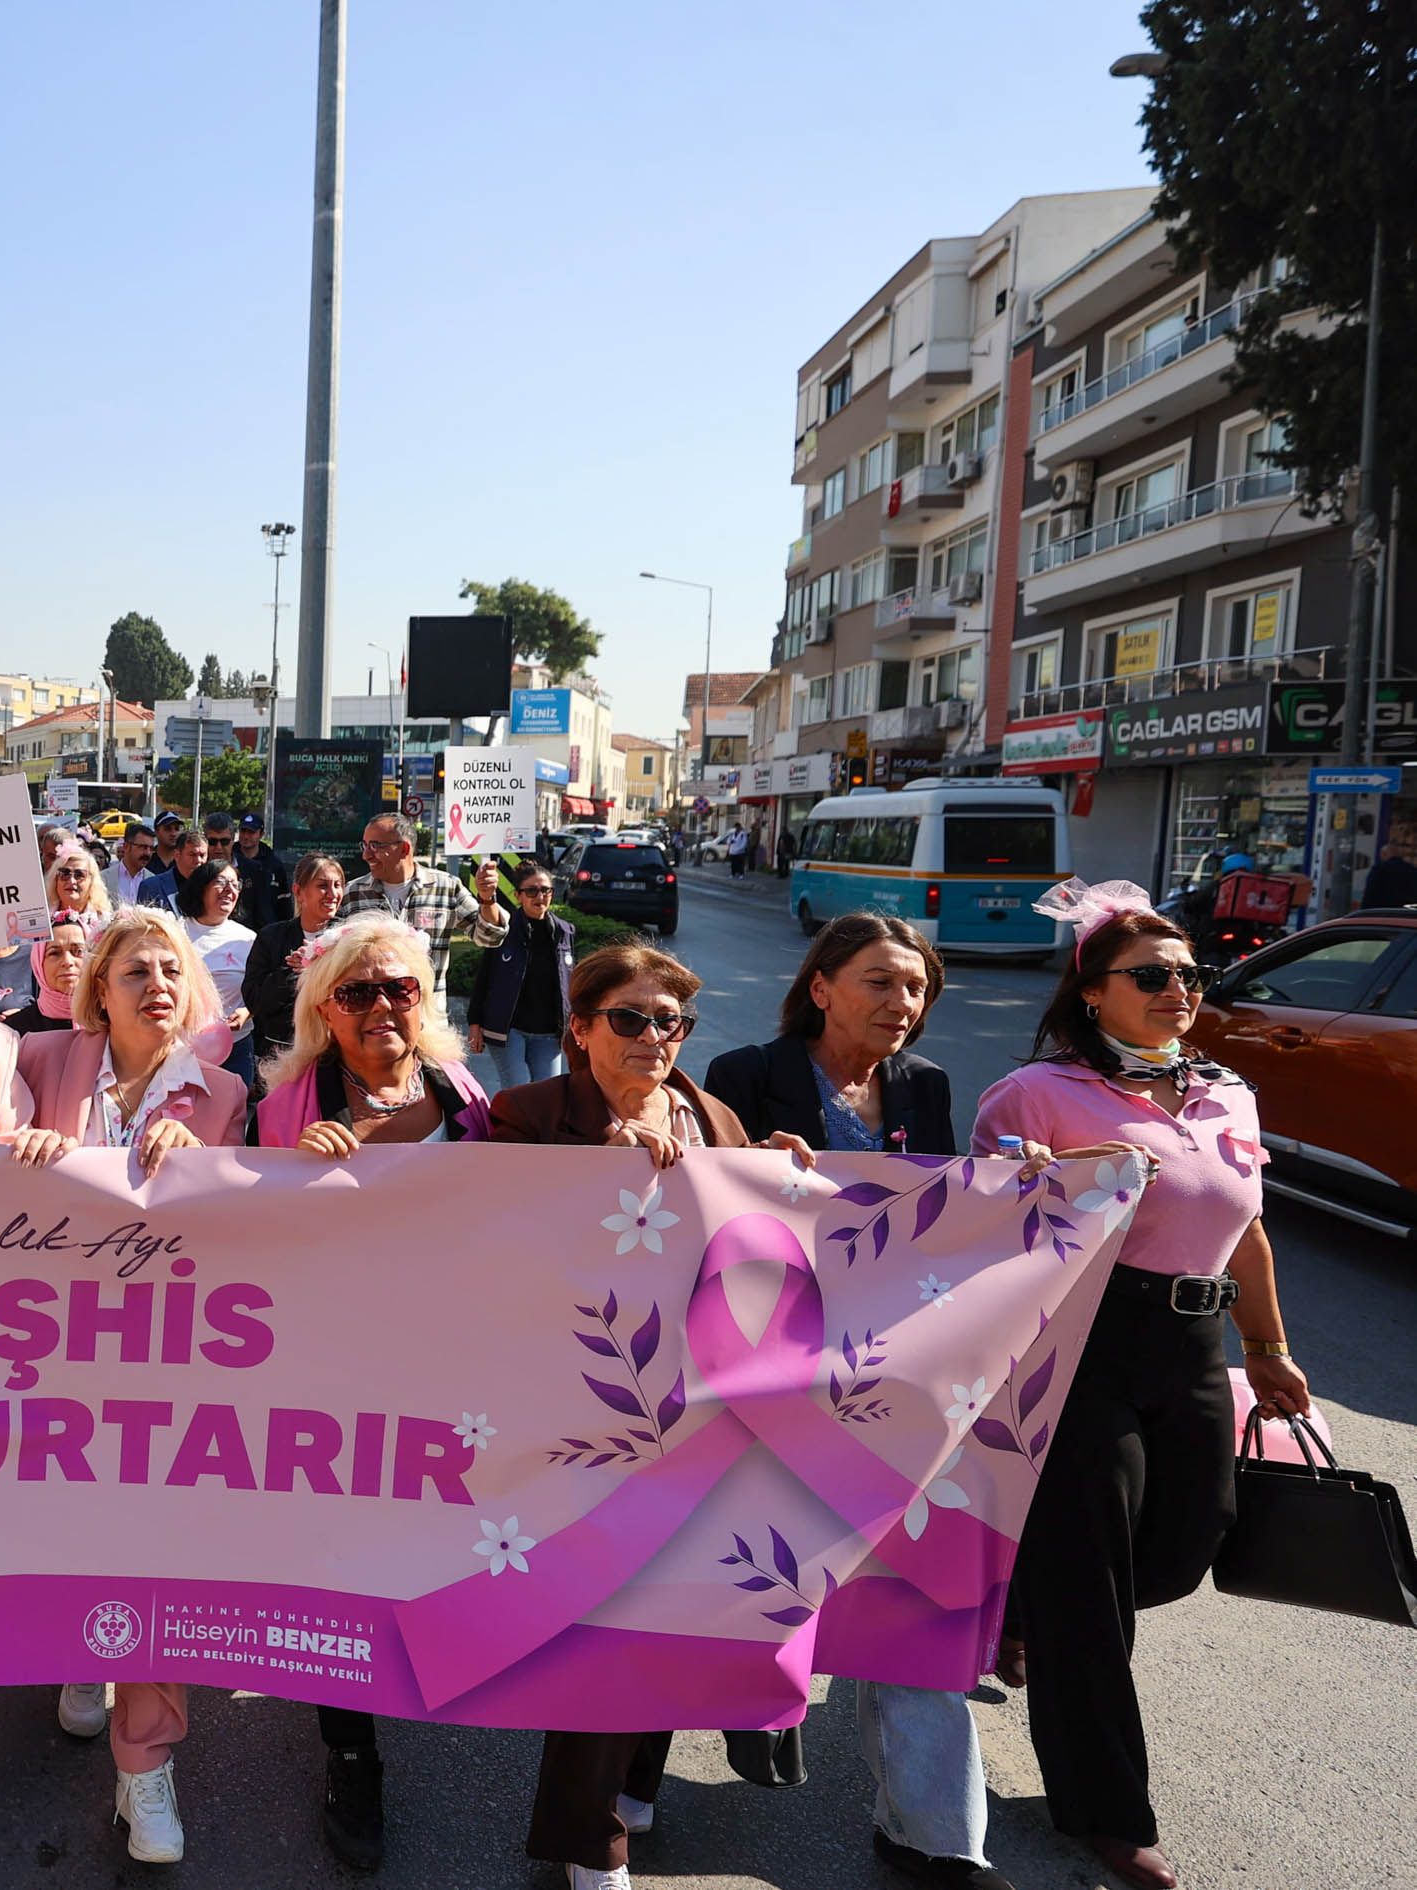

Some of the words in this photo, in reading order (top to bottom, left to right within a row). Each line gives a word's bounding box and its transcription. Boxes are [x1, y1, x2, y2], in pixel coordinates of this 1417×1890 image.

[523, 706, 558, 719] DENİZ
[1206, 705, 1262, 734] GSM
[289, 754, 314, 762] BUCA
[316, 754, 340, 763] HALK
[463, 759, 512, 773] DÜZENLİ
[453, 778, 507, 790] KONTROL
[509, 778, 527, 789] OL
[463, 795, 514, 807] HAYATINI
[466, 812, 511, 824] KURTAR
[96, 1604, 131, 1616] BUCA
[165, 1603, 241, 1617] MAKİNE
[257, 1608, 374, 1635] MÜHENDİSİ
[164, 1618, 258, 1647] Hüseyin
[266, 1625, 372, 1662] BENZER
[163, 1647, 198, 1659] BUCA
[203, 1650, 265, 1667] BELEDİYE
[269, 1657, 323, 1676] BAŞKAN
[329, 1666, 373, 1684] VEKİLİ
